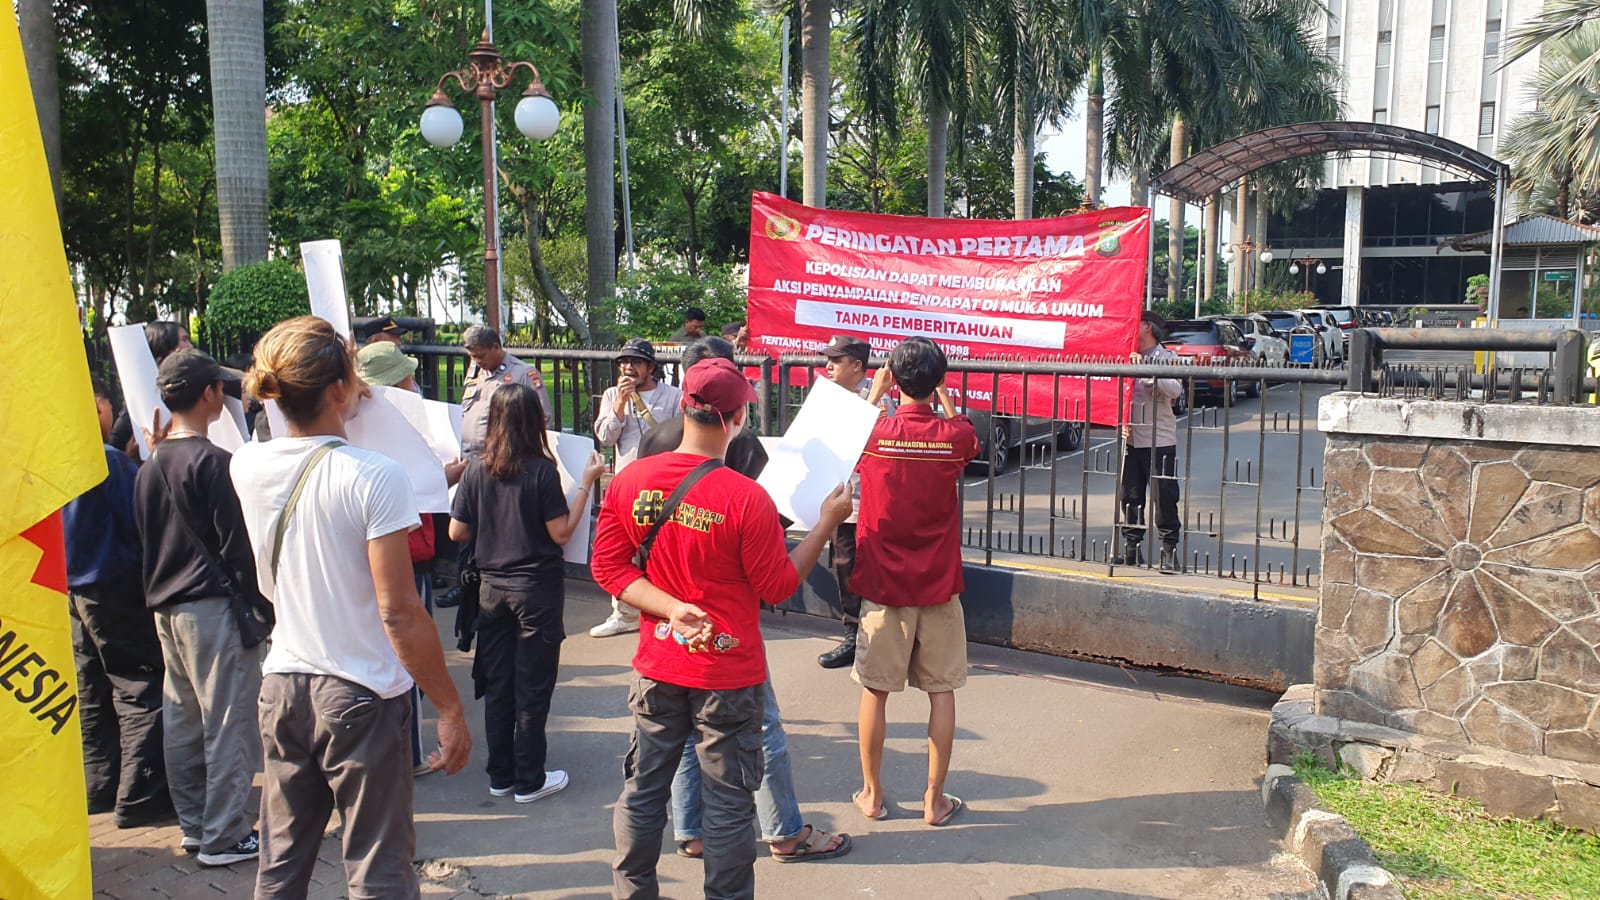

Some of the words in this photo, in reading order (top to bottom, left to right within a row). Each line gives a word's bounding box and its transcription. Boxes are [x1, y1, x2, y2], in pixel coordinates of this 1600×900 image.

[805, 223, 957, 256] PERINGATAN
[961, 235, 1086, 257] PERTAMA
[805, 261, 887, 281] KEPOLISIAN
[888, 271, 937, 286] DAPAT
[938, 274, 1062, 293] MEMBUBARKAN
[773, 279, 801, 294] AKSI
[803, 282, 899, 302] PENYAMPAIAN
[901, 293, 980, 311] PENDAPAT
[981, 300, 997, 312] DI
[1000, 302, 1049, 316] MUKA
[1051, 303, 1104, 318] UMUM
[835, 310, 879, 327] TANPA
[883, 315, 1013, 339] PEMBERITAHUAN
[761, 335, 801, 348] TENTANG
[868, 336, 882, 347] UU
[945, 344, 969, 356] 1998
[698, 508, 725, 525] BARU
[0, 625, 78, 735] NESIA
